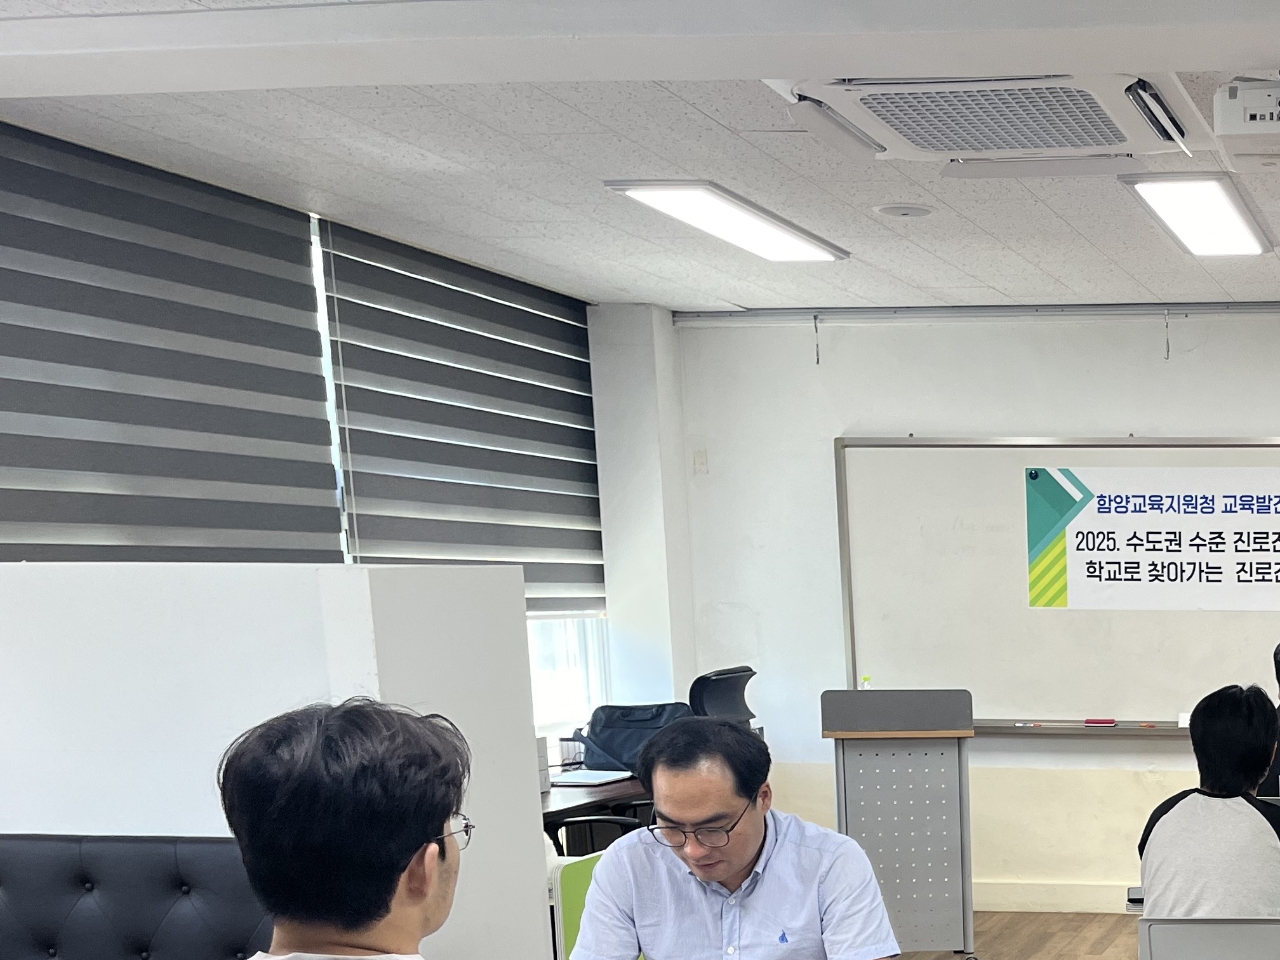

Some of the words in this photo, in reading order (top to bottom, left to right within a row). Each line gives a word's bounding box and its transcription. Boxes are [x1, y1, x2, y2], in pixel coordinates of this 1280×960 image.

[1096, 494, 1215, 514] 함양교육지원청
[1075, 531, 1120, 552] 2025.
[1126, 531, 1182, 552] 수도권
[1188, 531, 1226, 552] 수준
[1086, 560, 1142, 582] 학교로
[1148, 561, 1223, 582] 찾아가는
